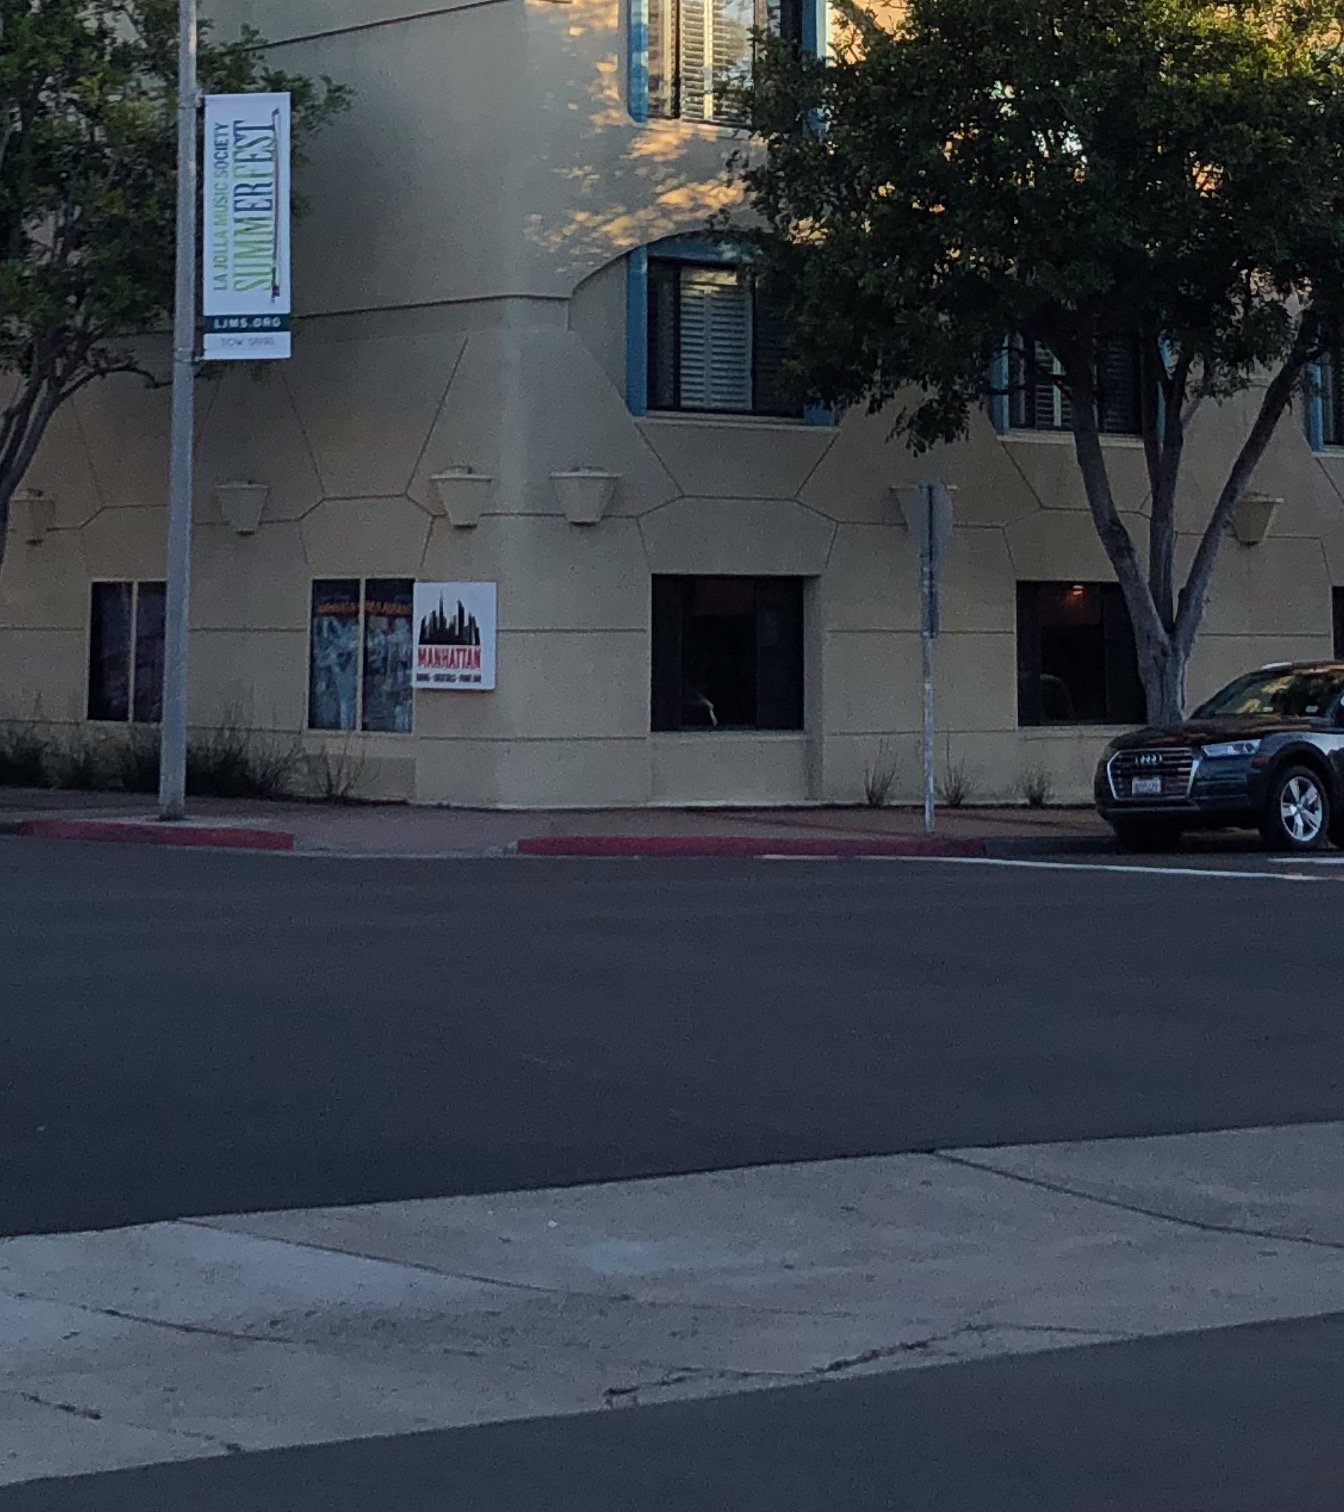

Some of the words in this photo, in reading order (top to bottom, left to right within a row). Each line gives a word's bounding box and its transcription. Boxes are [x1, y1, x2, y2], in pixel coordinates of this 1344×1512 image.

[214, 122, 228, 179] SOCIETY
[214, 183, 228, 226] MUSIC
[233, 120, 275, 292] SUMMERFEST
[213, 230, 228, 269] JOLLA
[213, 274, 228, 290] LA
[213, 317, 282, 329] LJMS.ORG
[418, 647, 481, 668] MANHATTAN
